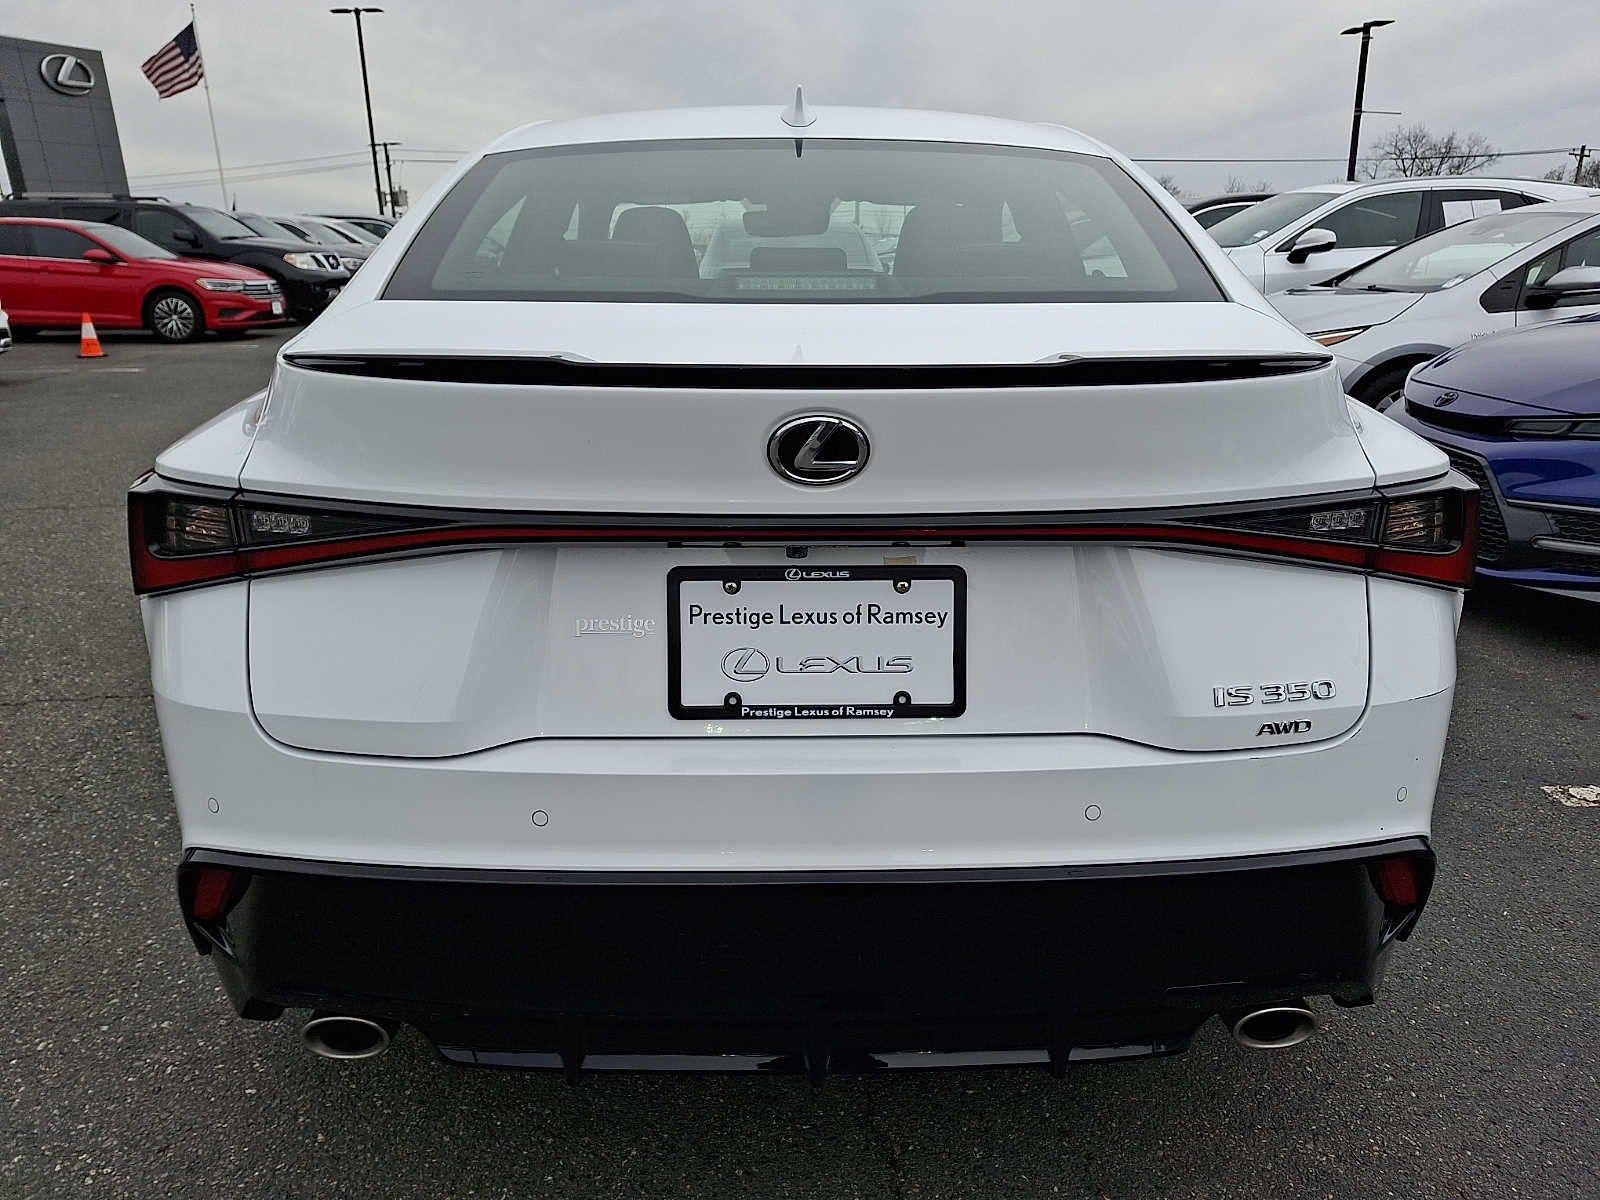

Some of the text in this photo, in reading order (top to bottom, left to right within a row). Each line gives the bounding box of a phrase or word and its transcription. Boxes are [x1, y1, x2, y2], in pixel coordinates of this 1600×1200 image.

[575, 614, 656, 638] prestige
[689, 603, 948, 630] Prestige Lexus of Ramsey
[775, 656, 914, 674] LEXUS
[1213, 679, 1336, 708] IS 350
[741, 706, 894, 718] Prestige Lexus of Ramsey
[1255, 719, 1312, 736] AWD
